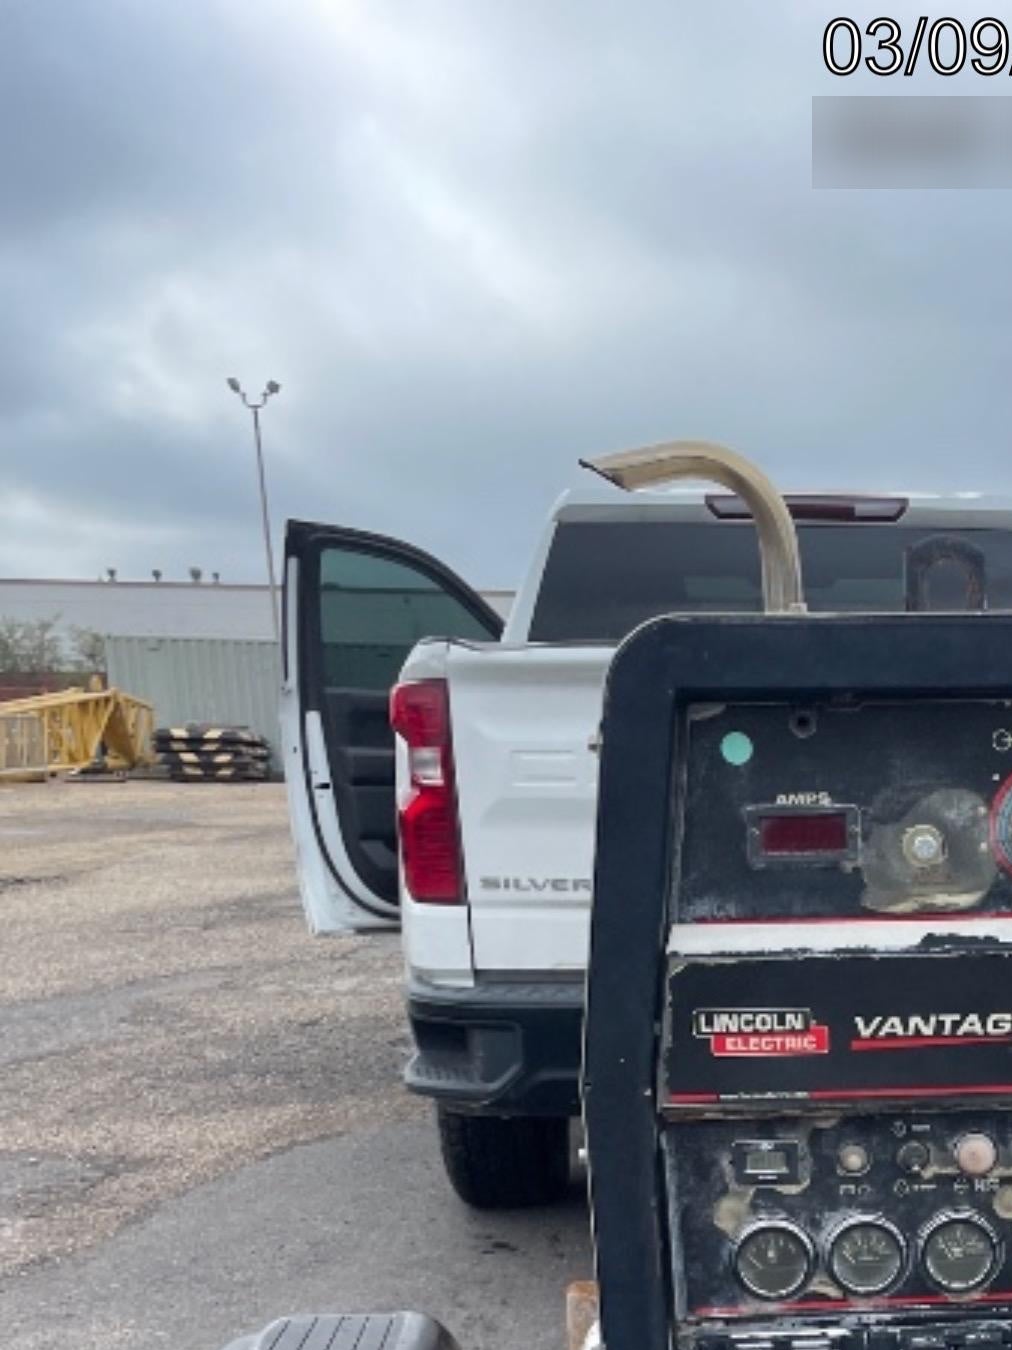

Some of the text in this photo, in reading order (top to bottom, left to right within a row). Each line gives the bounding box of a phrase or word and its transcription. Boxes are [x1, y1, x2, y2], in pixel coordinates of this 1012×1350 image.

[775, 791, 832, 806] AMPS
[699, 1012, 805, 1034] LINCOLN
[724, 1034, 818, 1051] ELECTRIC
